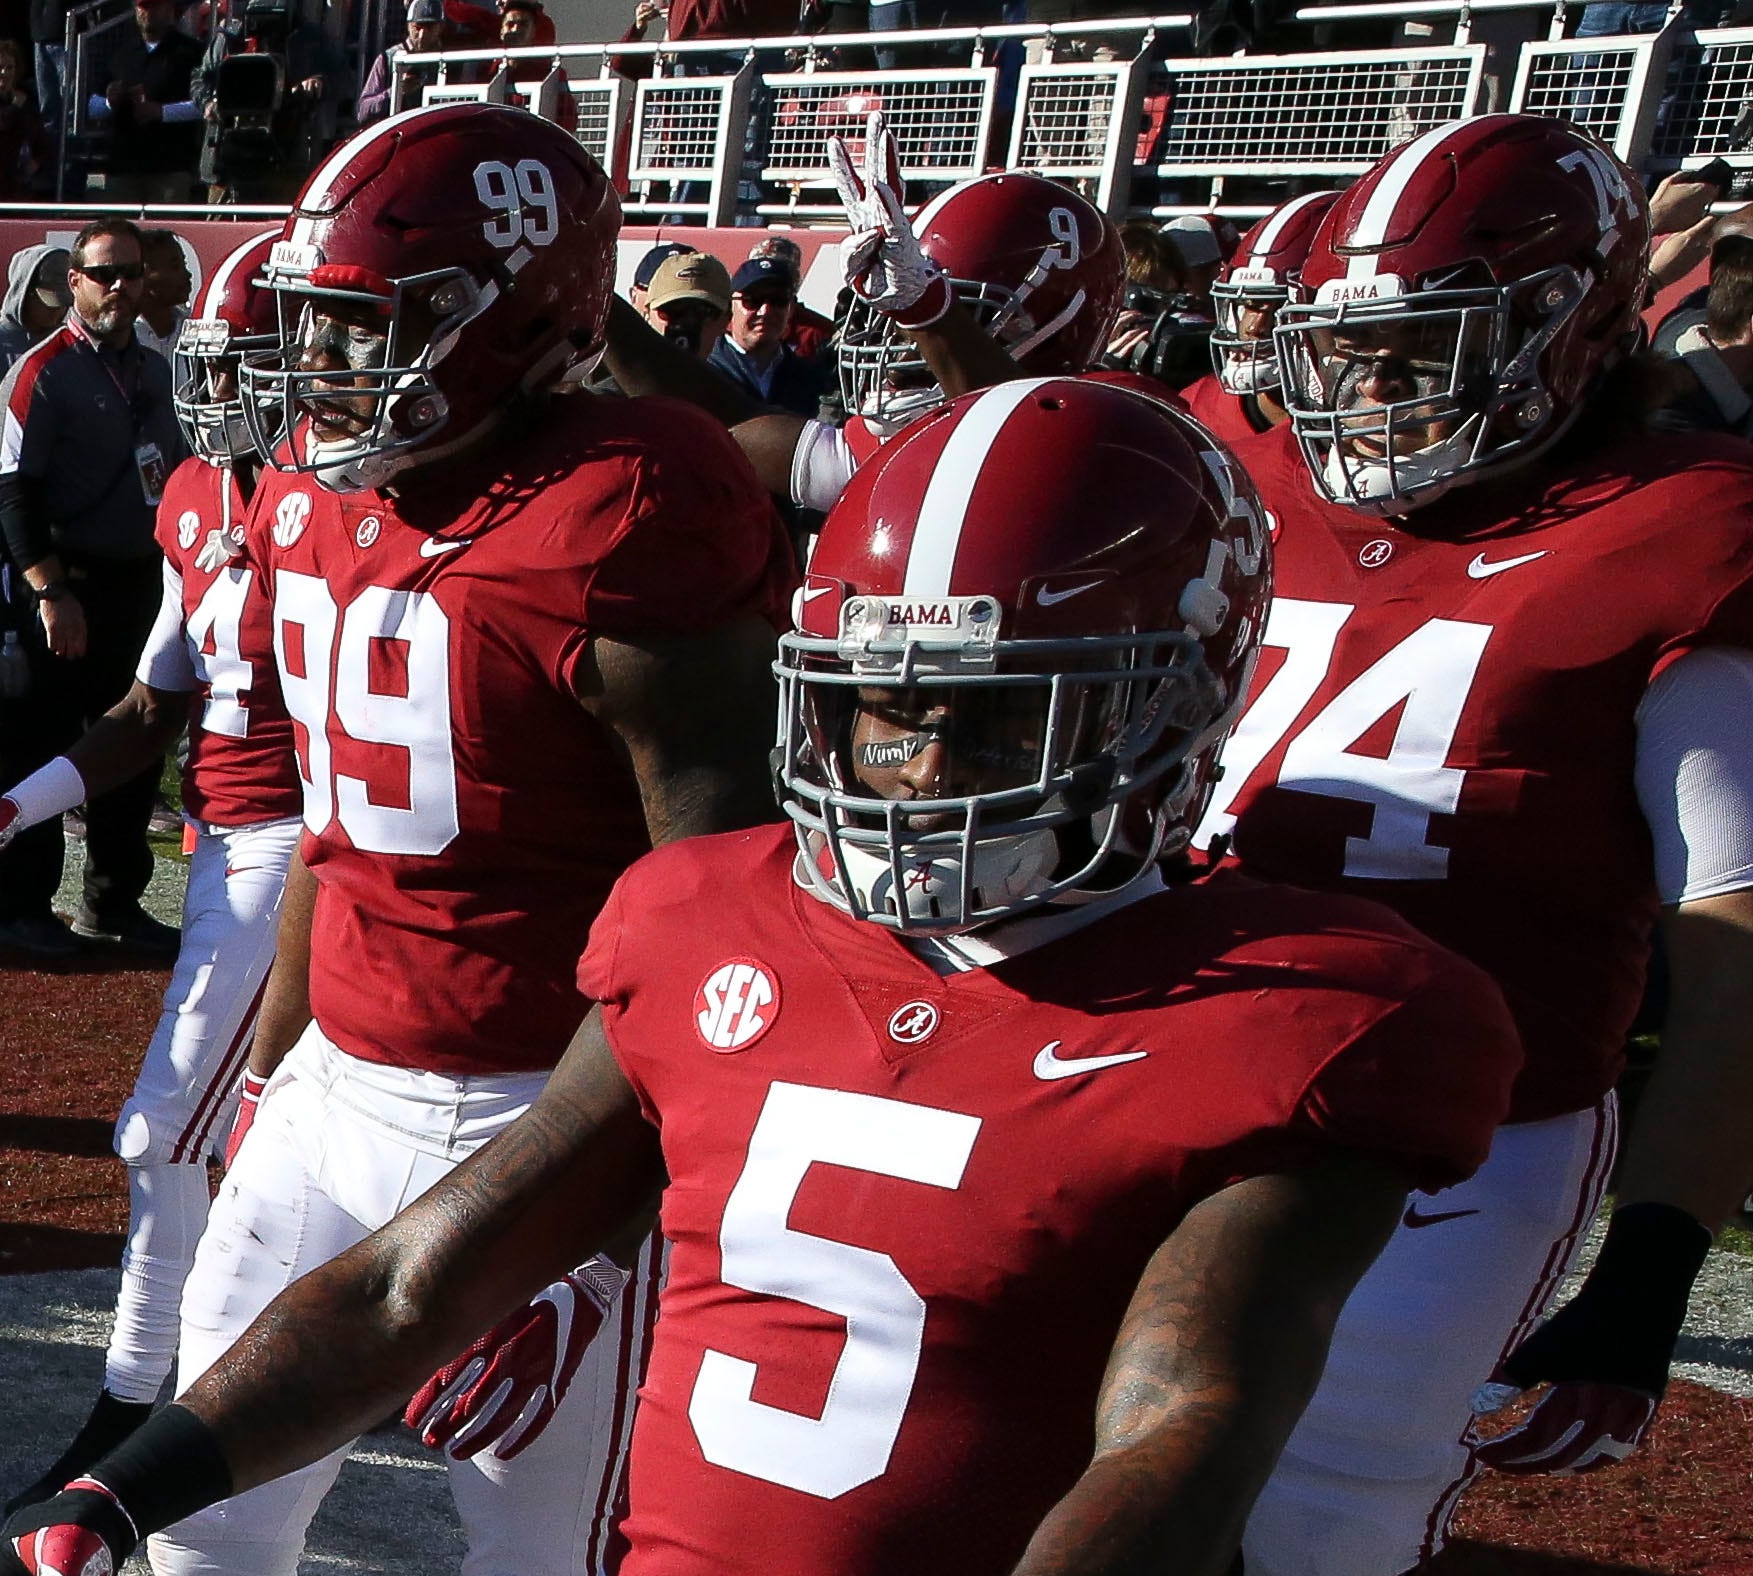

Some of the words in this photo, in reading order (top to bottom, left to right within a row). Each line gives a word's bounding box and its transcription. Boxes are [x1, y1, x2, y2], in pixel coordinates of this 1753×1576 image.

[473, 160, 558, 248] 99
[1556, 149, 1640, 232] 74
[1049, 207, 1079, 270] 9
[1332, 285, 1379, 303] BAMA
[1200, 451, 1263, 577] 5
[888, 604, 953, 625] BAMA
[273, 568, 460, 856] 99
[1189, 597, 1495, 880] 74
[697, 963, 773, 1048] SEC
[687, 1079, 984, 1500] 5
